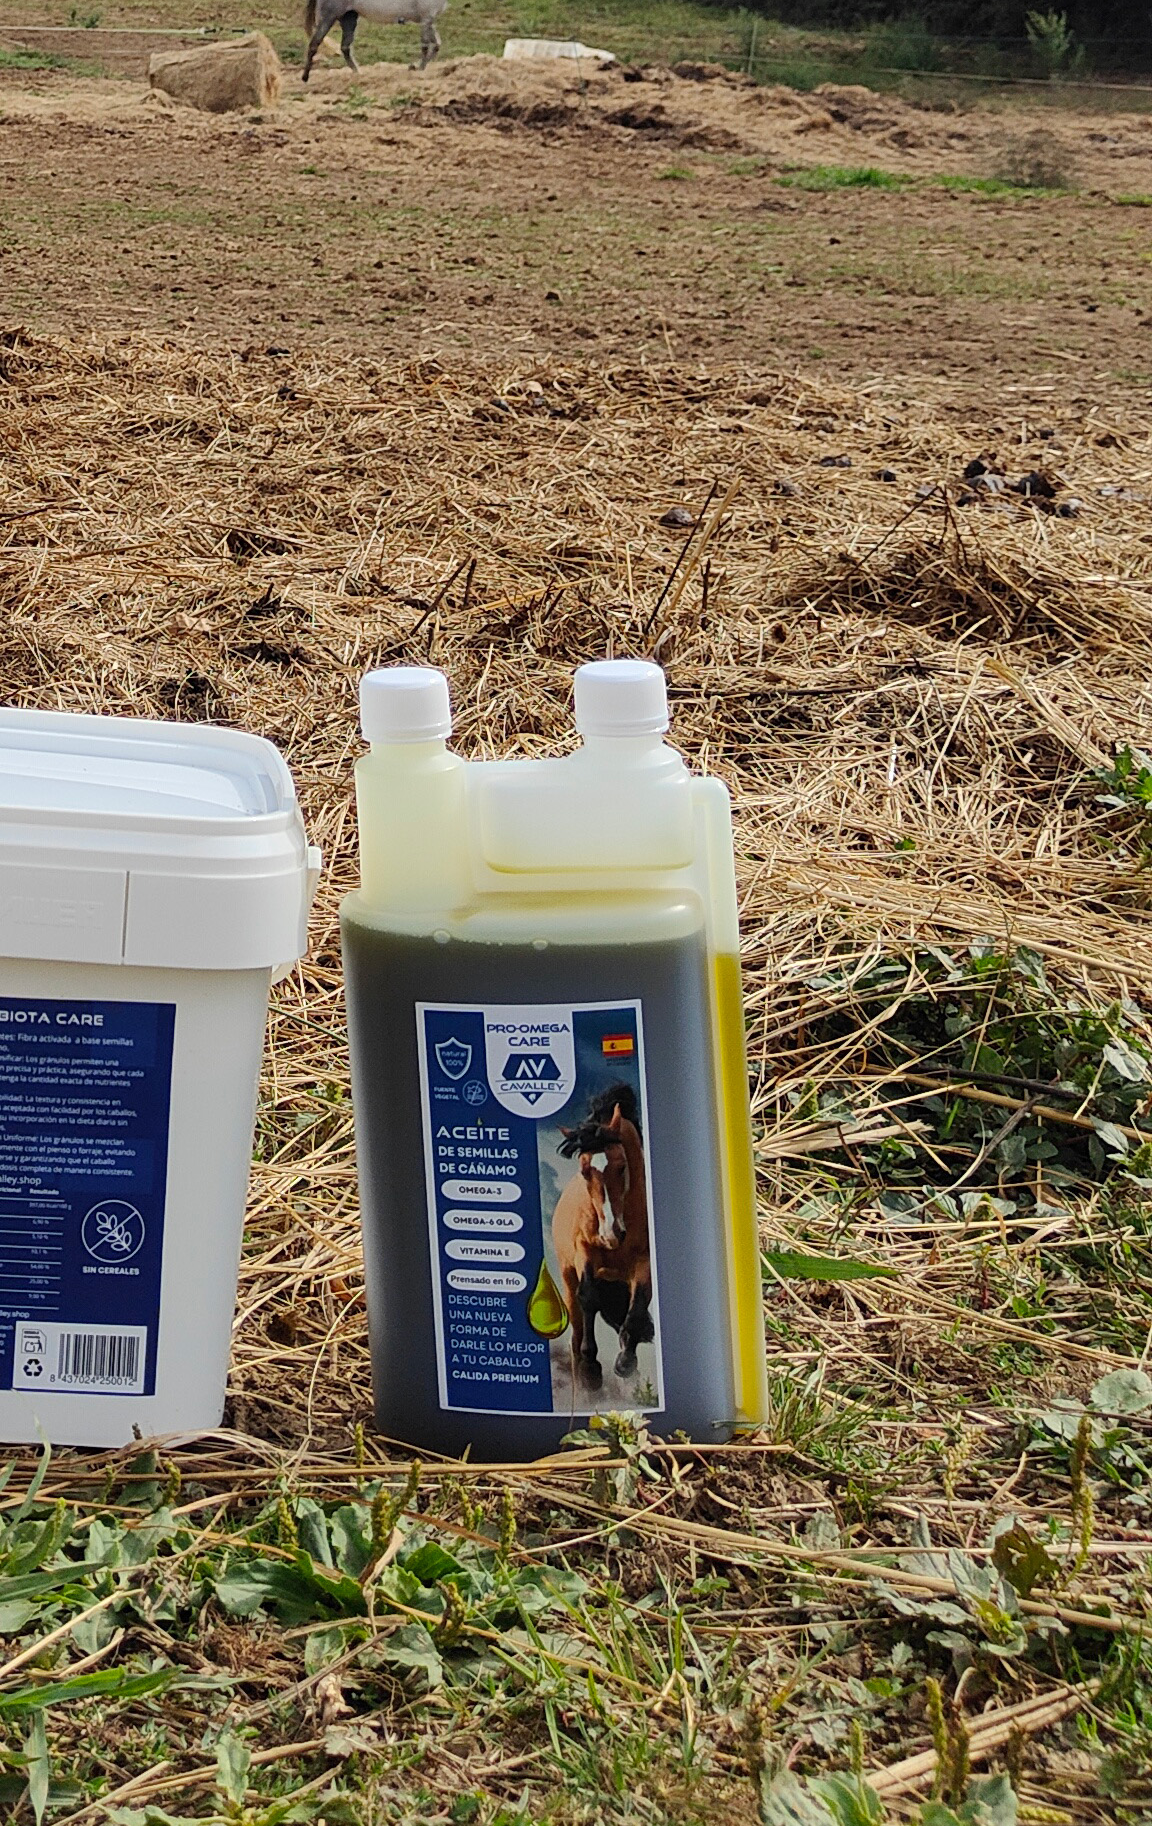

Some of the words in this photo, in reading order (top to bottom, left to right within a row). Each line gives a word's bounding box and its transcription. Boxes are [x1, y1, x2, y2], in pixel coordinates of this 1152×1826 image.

[56, 1013, 104, 1027] CARE
[486, 1023, 571, 1034] PRO-OMEGA
[508, 1036, 551, 1047] CARE
[499, 1080, 566, 1093] CAVALLEY
[436, 1125, 510, 1141] ACEITE
[438, 1145, 455, 1157] DE
[457, 1146, 519, 1159] SEMILLAS
[439, 1162, 456, 1174] DE
[458, 1161, 517, 1176] CÁÑAMO
[458, 1185, 502, 1196] OMEGA-3
[453, 1216, 495, 1226] OMEGA-6
[495, 1218, 515, 1226] GLA
[459, 1246, 503, 1256] VITAMINA
[504, 1249, 510, 1257] E
[82, 1266, 97, 1274] SIN
[97, 1266, 140, 1276] CEREALES
[450, 1274, 491, 1285] Prensado
[505, 1277, 521, 1286] frío
[448, 1294, 508, 1308] DESCUBRE
[449, 1309, 473, 1320] UNA
[475, 1311, 513, 1323] NUEVA
[450, 1324, 490, 1336] FORMA
[492, 1326, 507, 1337] DE
[450, 1338, 486, 1351] DARLE
[488, 1341, 505, 1352] LO
[506, 1342, 545, 1353] MEJOR
[451, 1353, 460, 1363] A
[461, 1354, 477, 1365] TU
[478, 1355, 532, 1368] CABALLO
[61, 1375, 96, 1385] 437024
[99, 1376, 135, 1386] 250012
[452, 1370, 491, 1381] CALIDA
[491, 1373, 539, 1384] PREMIUM
